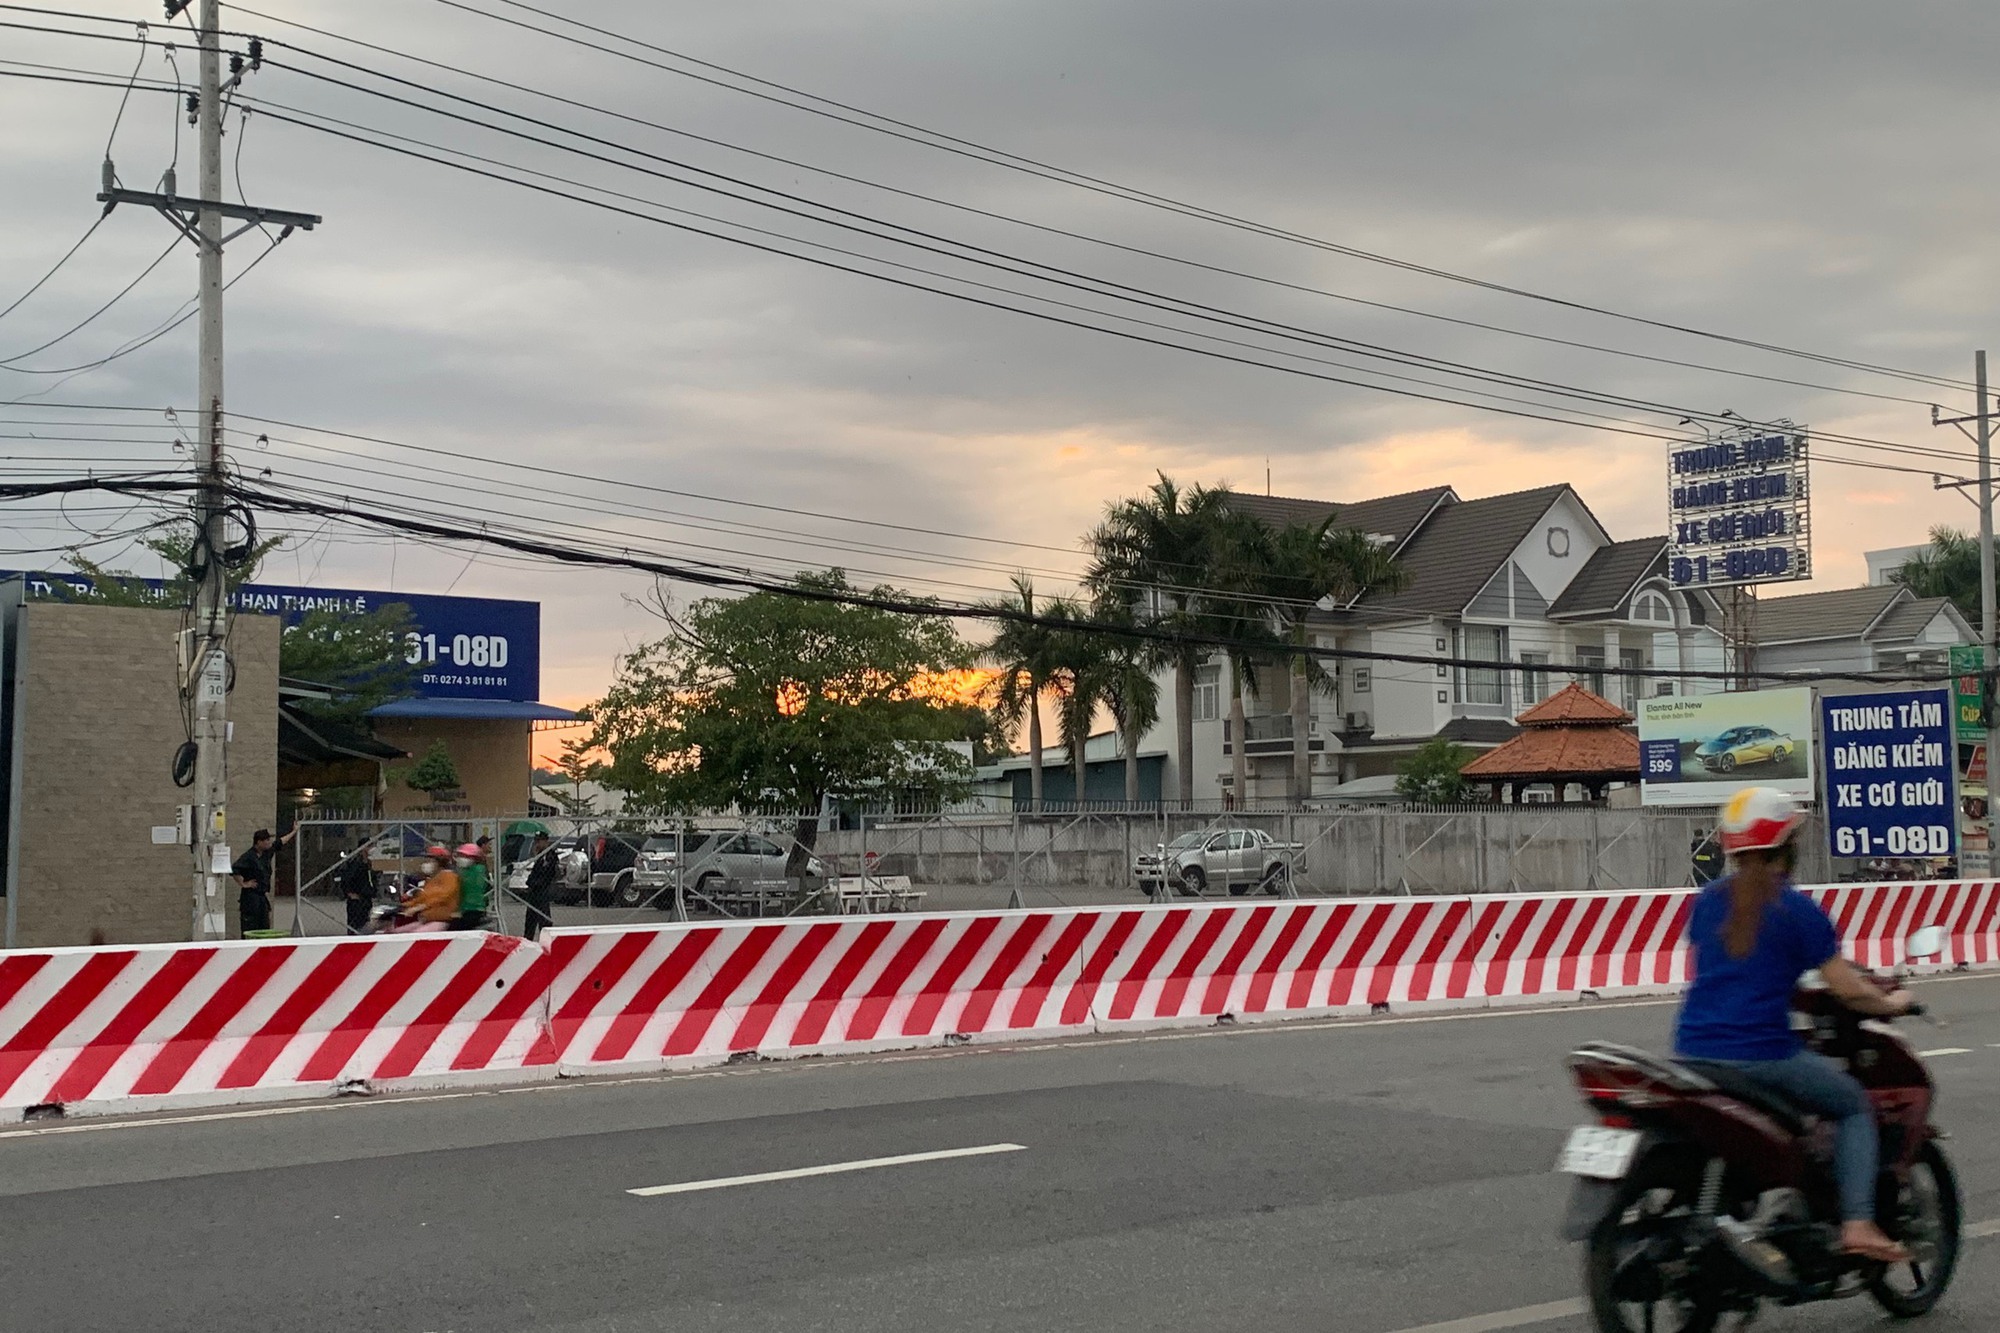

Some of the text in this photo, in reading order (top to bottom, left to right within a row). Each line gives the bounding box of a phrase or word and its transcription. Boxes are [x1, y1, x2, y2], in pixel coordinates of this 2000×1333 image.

[1672, 433, 1785, 474] TRUNG TÂM
[1673, 480, 1727, 509] ĐĂNG
[1676, 522, 1704, 544] XE
[1708, 514, 1736, 541] CƠ
[1673, 547, 1788, 584] 61-08D
[282, 595, 340, 613] THANH
[404, 631, 508, 668] 61-08D
[423, 674, 507, 686] ĐT: 0274 3 81 81 81
[1959, 676, 1980, 695] XE
[1646, 702, 1702, 712] Elantra All New
[1830, 700, 1942, 731] TRUNG TÂM
[1649, 759, 1673, 773] 599
[1834, 734, 1943, 769] ĐĂNG KIỂM
[1837, 777, 1944, 807] XE CƠ GIỚI
[1837, 826, 1949, 854] 61-08D
